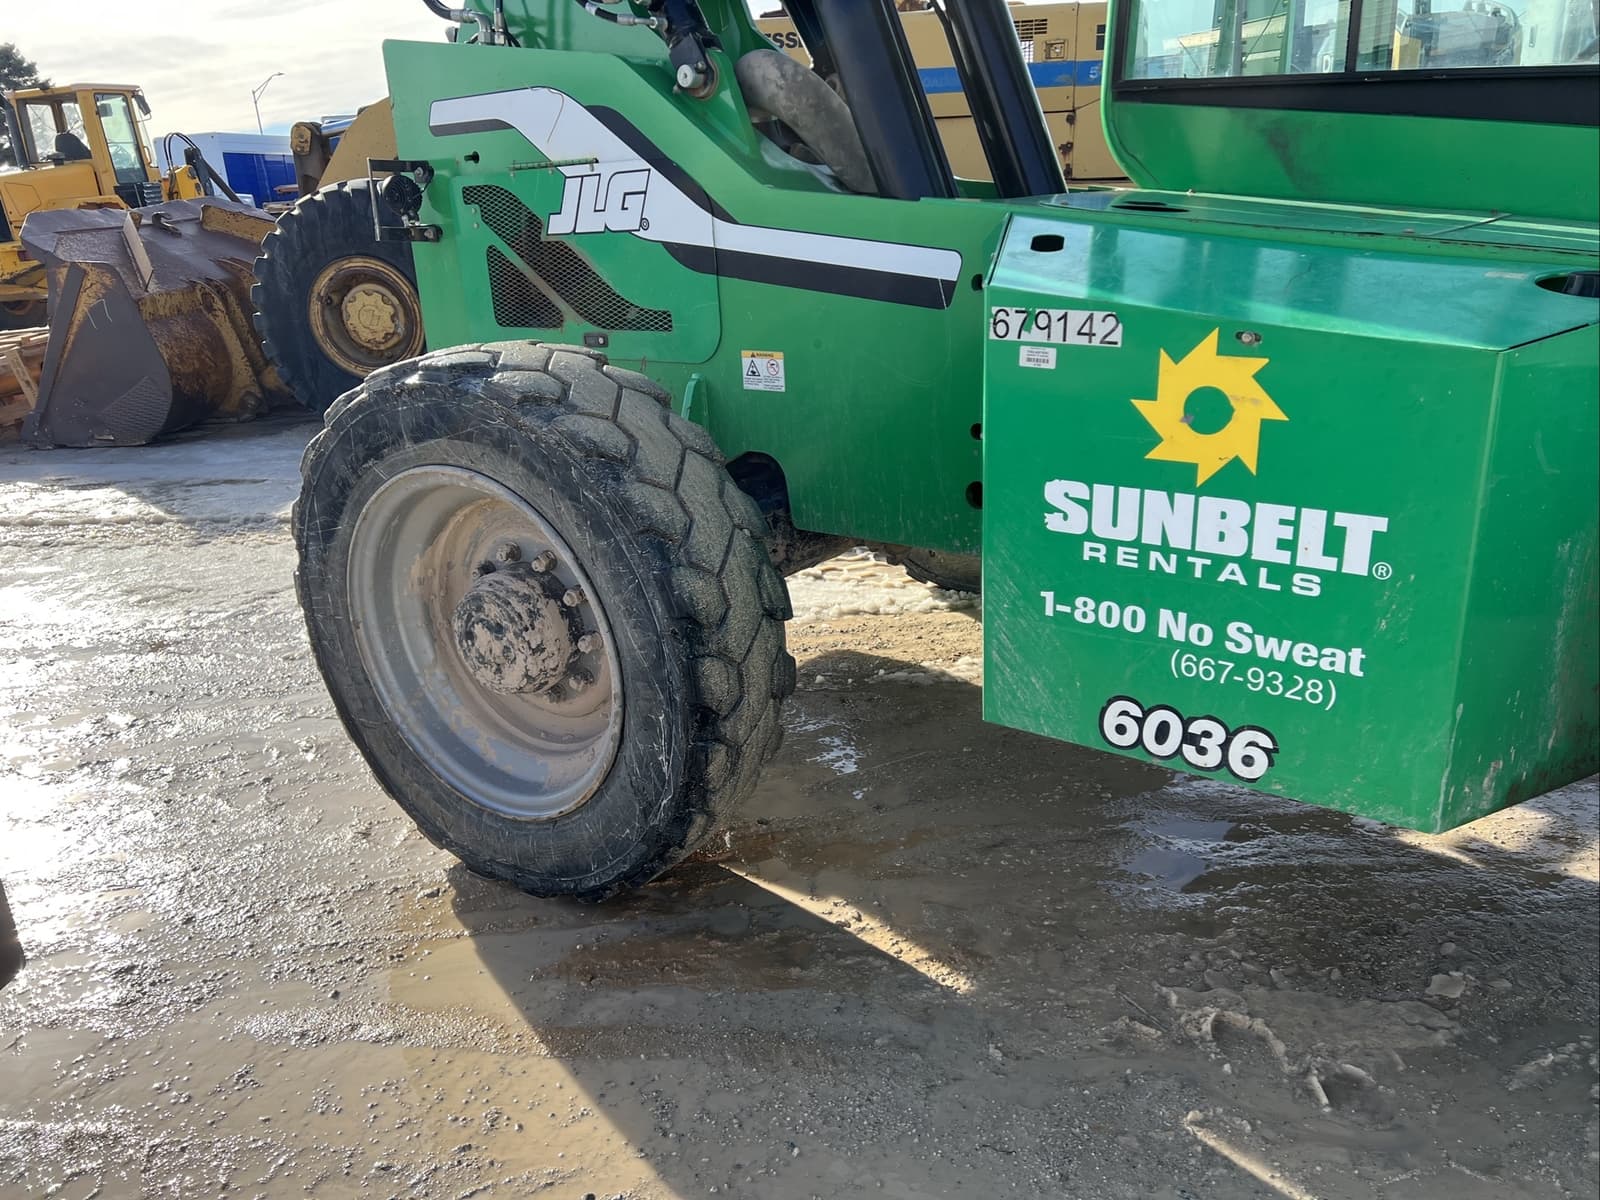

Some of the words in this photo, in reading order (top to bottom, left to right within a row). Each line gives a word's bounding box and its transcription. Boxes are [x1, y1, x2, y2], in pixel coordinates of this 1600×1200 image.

[547, 169, 651, 236] JLG
[992, 308, 1120, 345] 679142
[1083, 542, 1321, 597] RENTALS
[1040, 591, 1146, 633] 1-800
[1158, 608, 1213, 647] No
[1224, 621, 1366, 677] Sweat
[1171, 649, 1337, 711] (667-9328)
[1101, 696, 1278, 782] 6036
